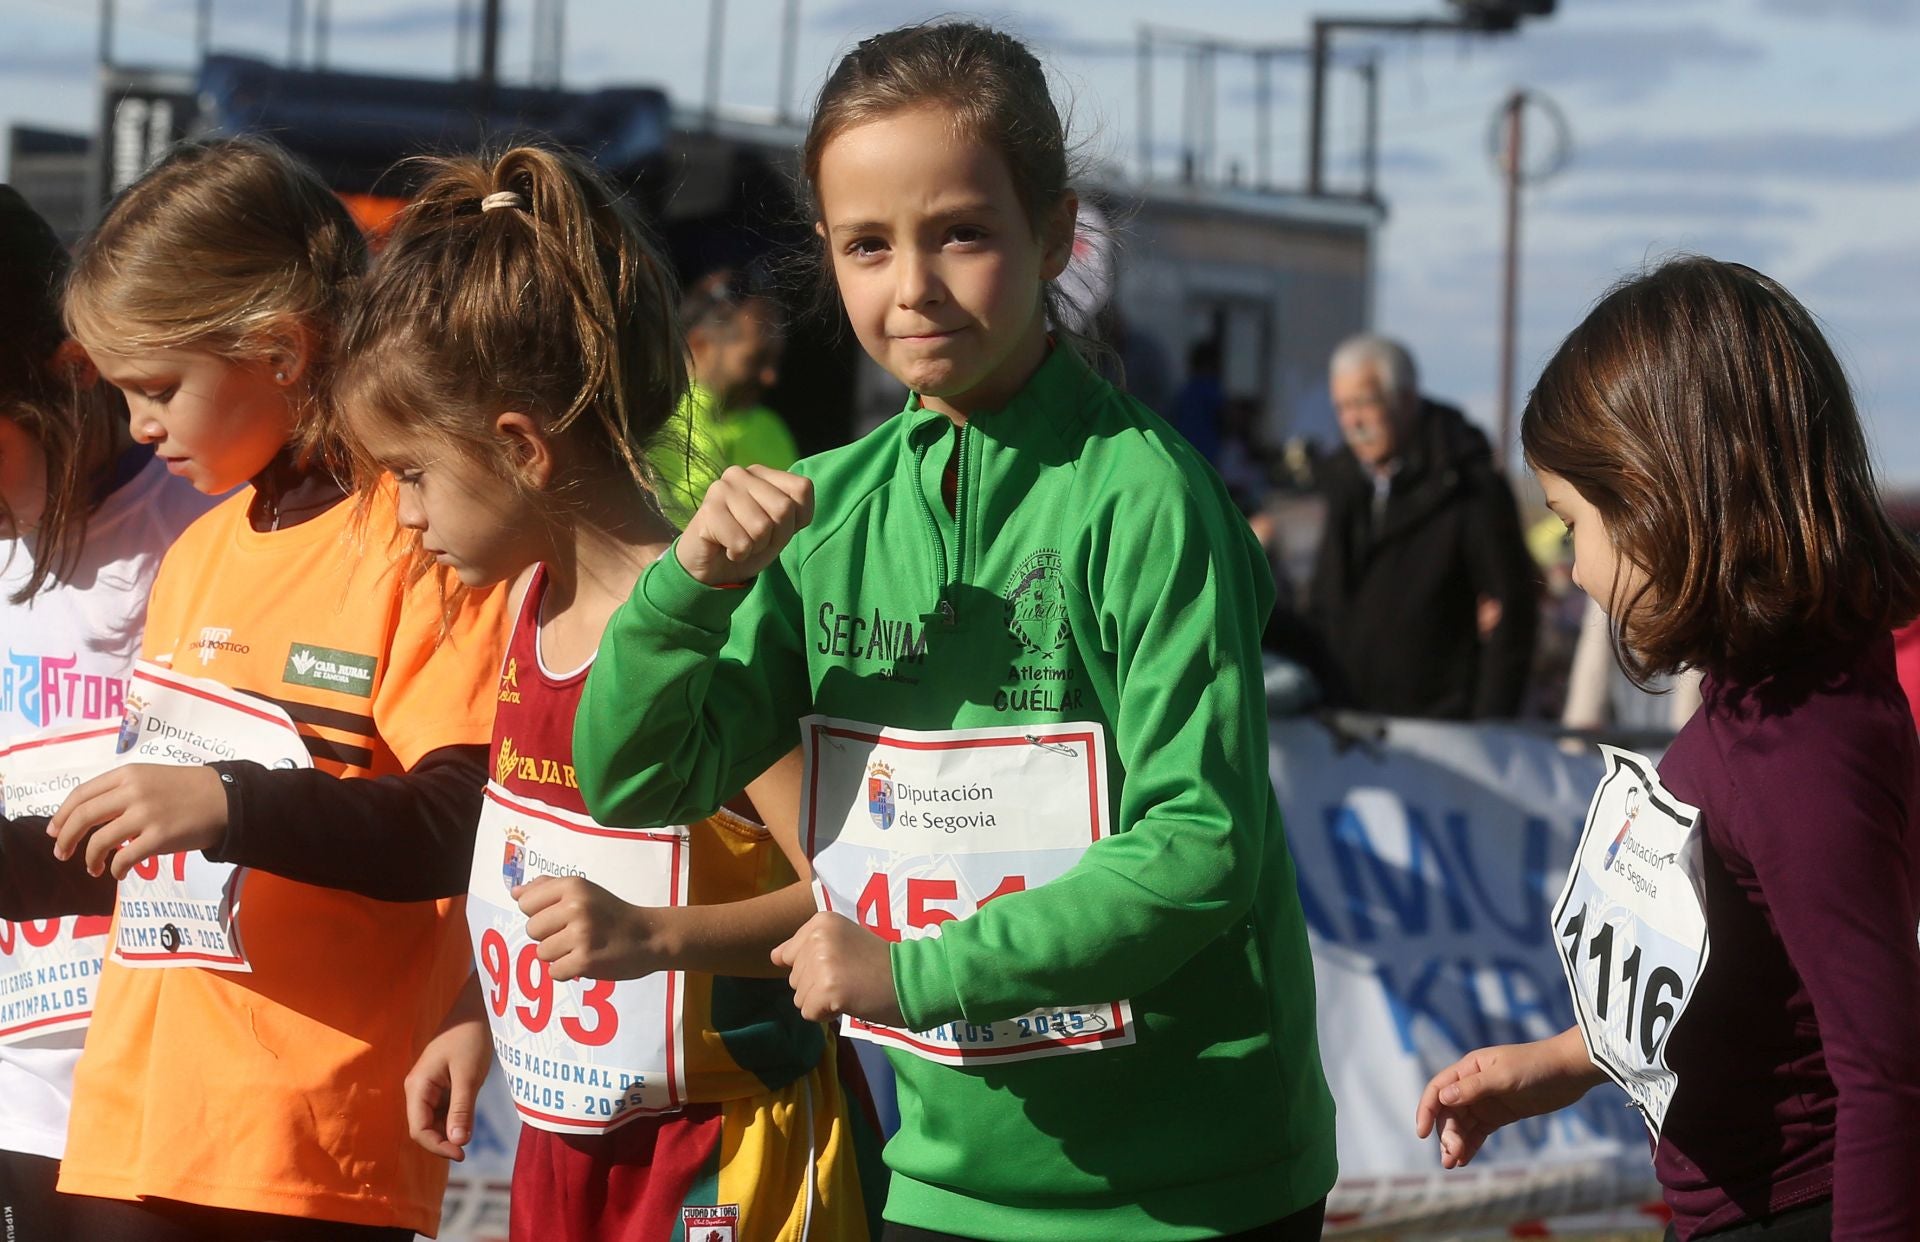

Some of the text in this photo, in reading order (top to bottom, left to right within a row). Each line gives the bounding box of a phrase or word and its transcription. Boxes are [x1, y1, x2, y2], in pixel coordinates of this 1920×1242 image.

[313, 670, 350, 684] DE ZAMORA
[315, 661, 371, 680] CAJA RURAL
[993, 684, 1083, 713] CUÉLLAR
[146, 716, 237, 760] Diputación
[140, 741, 207, 765] de Sego
[518, 756, 563, 785] CAJA
[897, 783, 993, 805] Diputación
[26, 803, 62, 819] Sego
[899, 810, 997, 834] de Segovia
[1614, 858, 1658, 900] de Segovia
[151, 901, 205, 921] NACIONAL
[198, 929, 225, 950] 2025
[36, 957, 104, 985] NACION
[1563, 901, 1684, 1065] 1116
[481, 928, 619, 1047] 993
[1016, 1010, 1084, 1039] 2025
[524, 1052, 612, 1089] NACIONAL
[619, 1072, 646, 1091] DE
[584, 1092, 643, 1116] 2025
[3, 1206, 15, 1242] KIPRU
[684, 1206, 737, 1218] CIUDAD DE TORO
